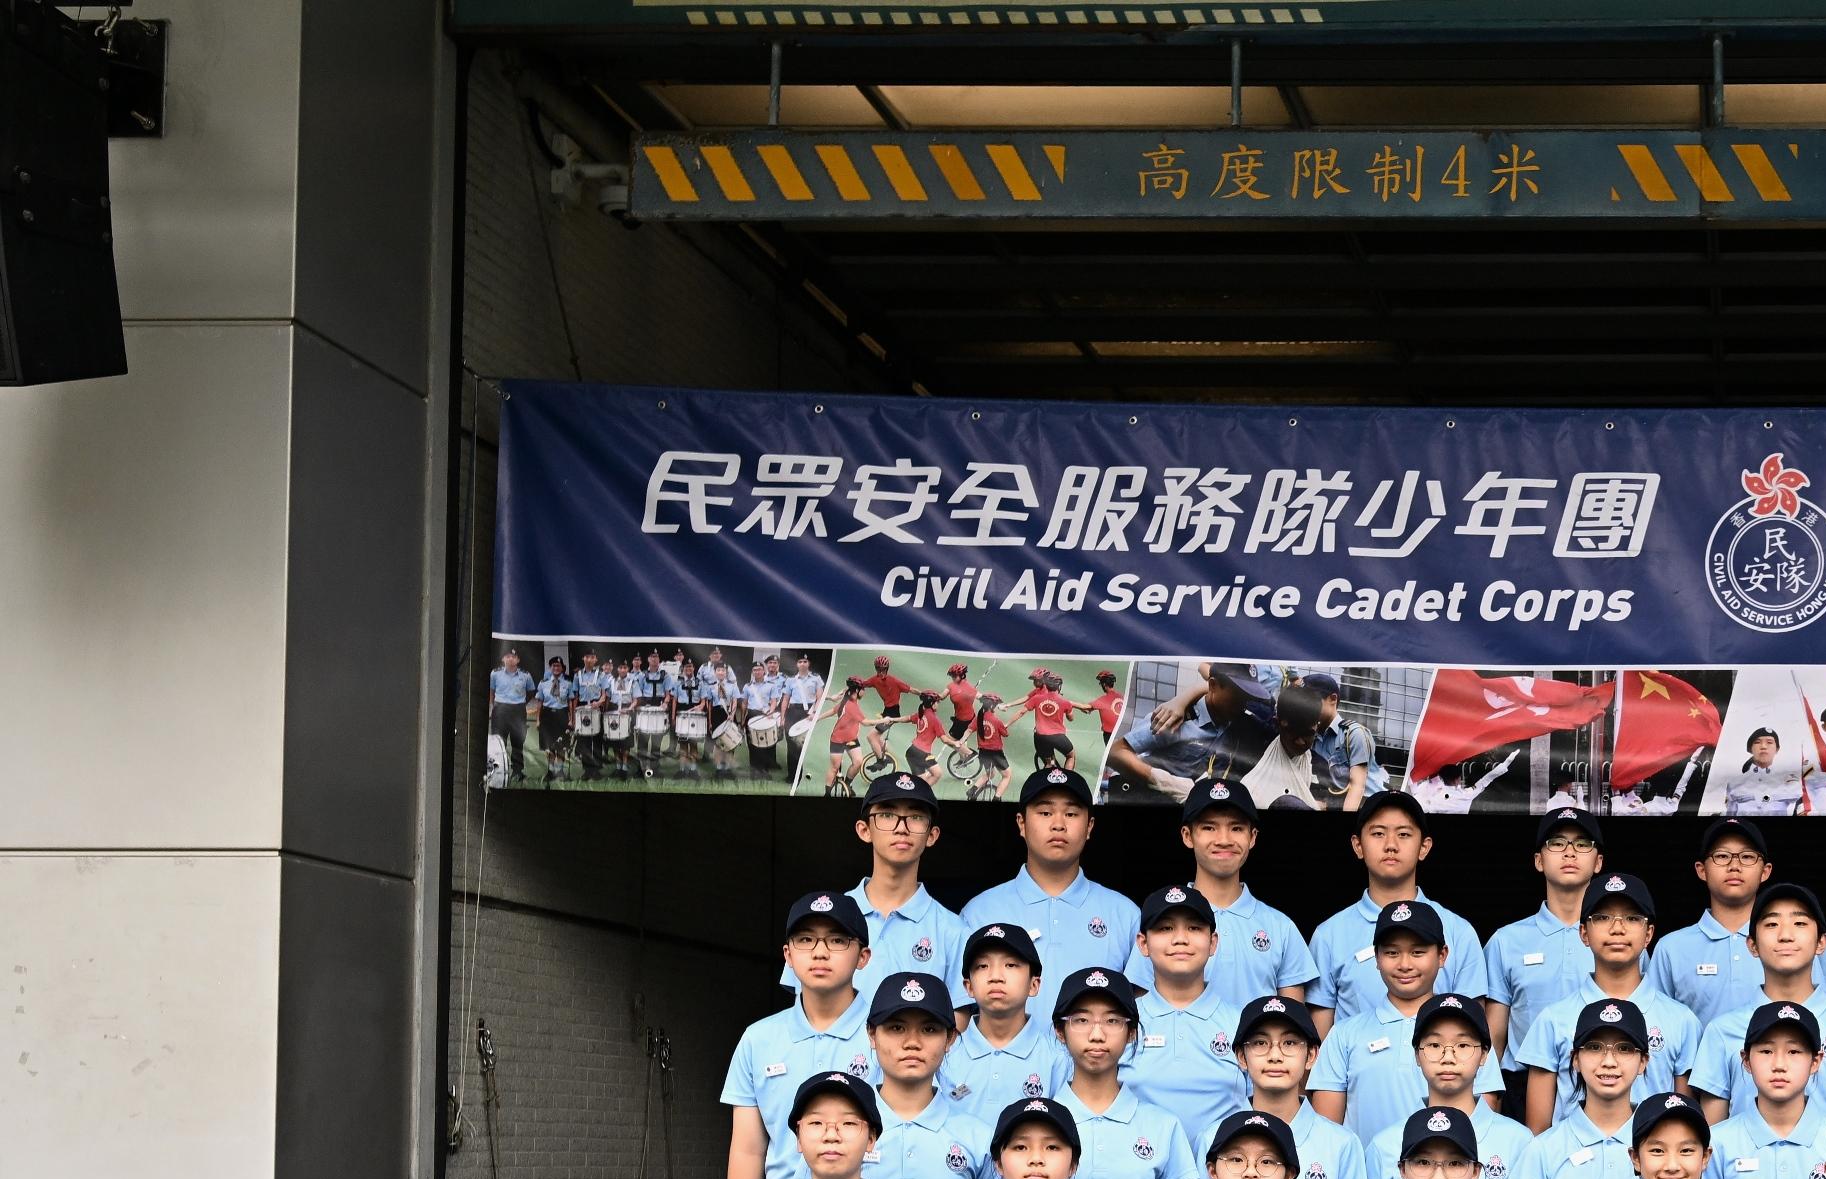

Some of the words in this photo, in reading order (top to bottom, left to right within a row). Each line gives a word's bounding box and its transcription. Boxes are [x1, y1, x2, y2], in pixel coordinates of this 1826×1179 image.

[1139, 143, 1543, 202] 高度限制4米
[640, 451, 1661, 560] 民眾安全服務隊少年團
[1764, 527, 1796, 559] 民
[880, 566, 993, 610] Civil
[999, 567, 1094, 612] Aid
[1098, 573, 1301, 619] Service
[1315, 577, 1466, 622] Cadet
[1479, 579, 1635, 631] Corps
[1713, 553, 1727, 587] CIVIL
[1721, 589, 1741, 610] AID
[1740, 608, 1794, 626] SERVICE
[1739, 557, 1811, 594] 安隊
